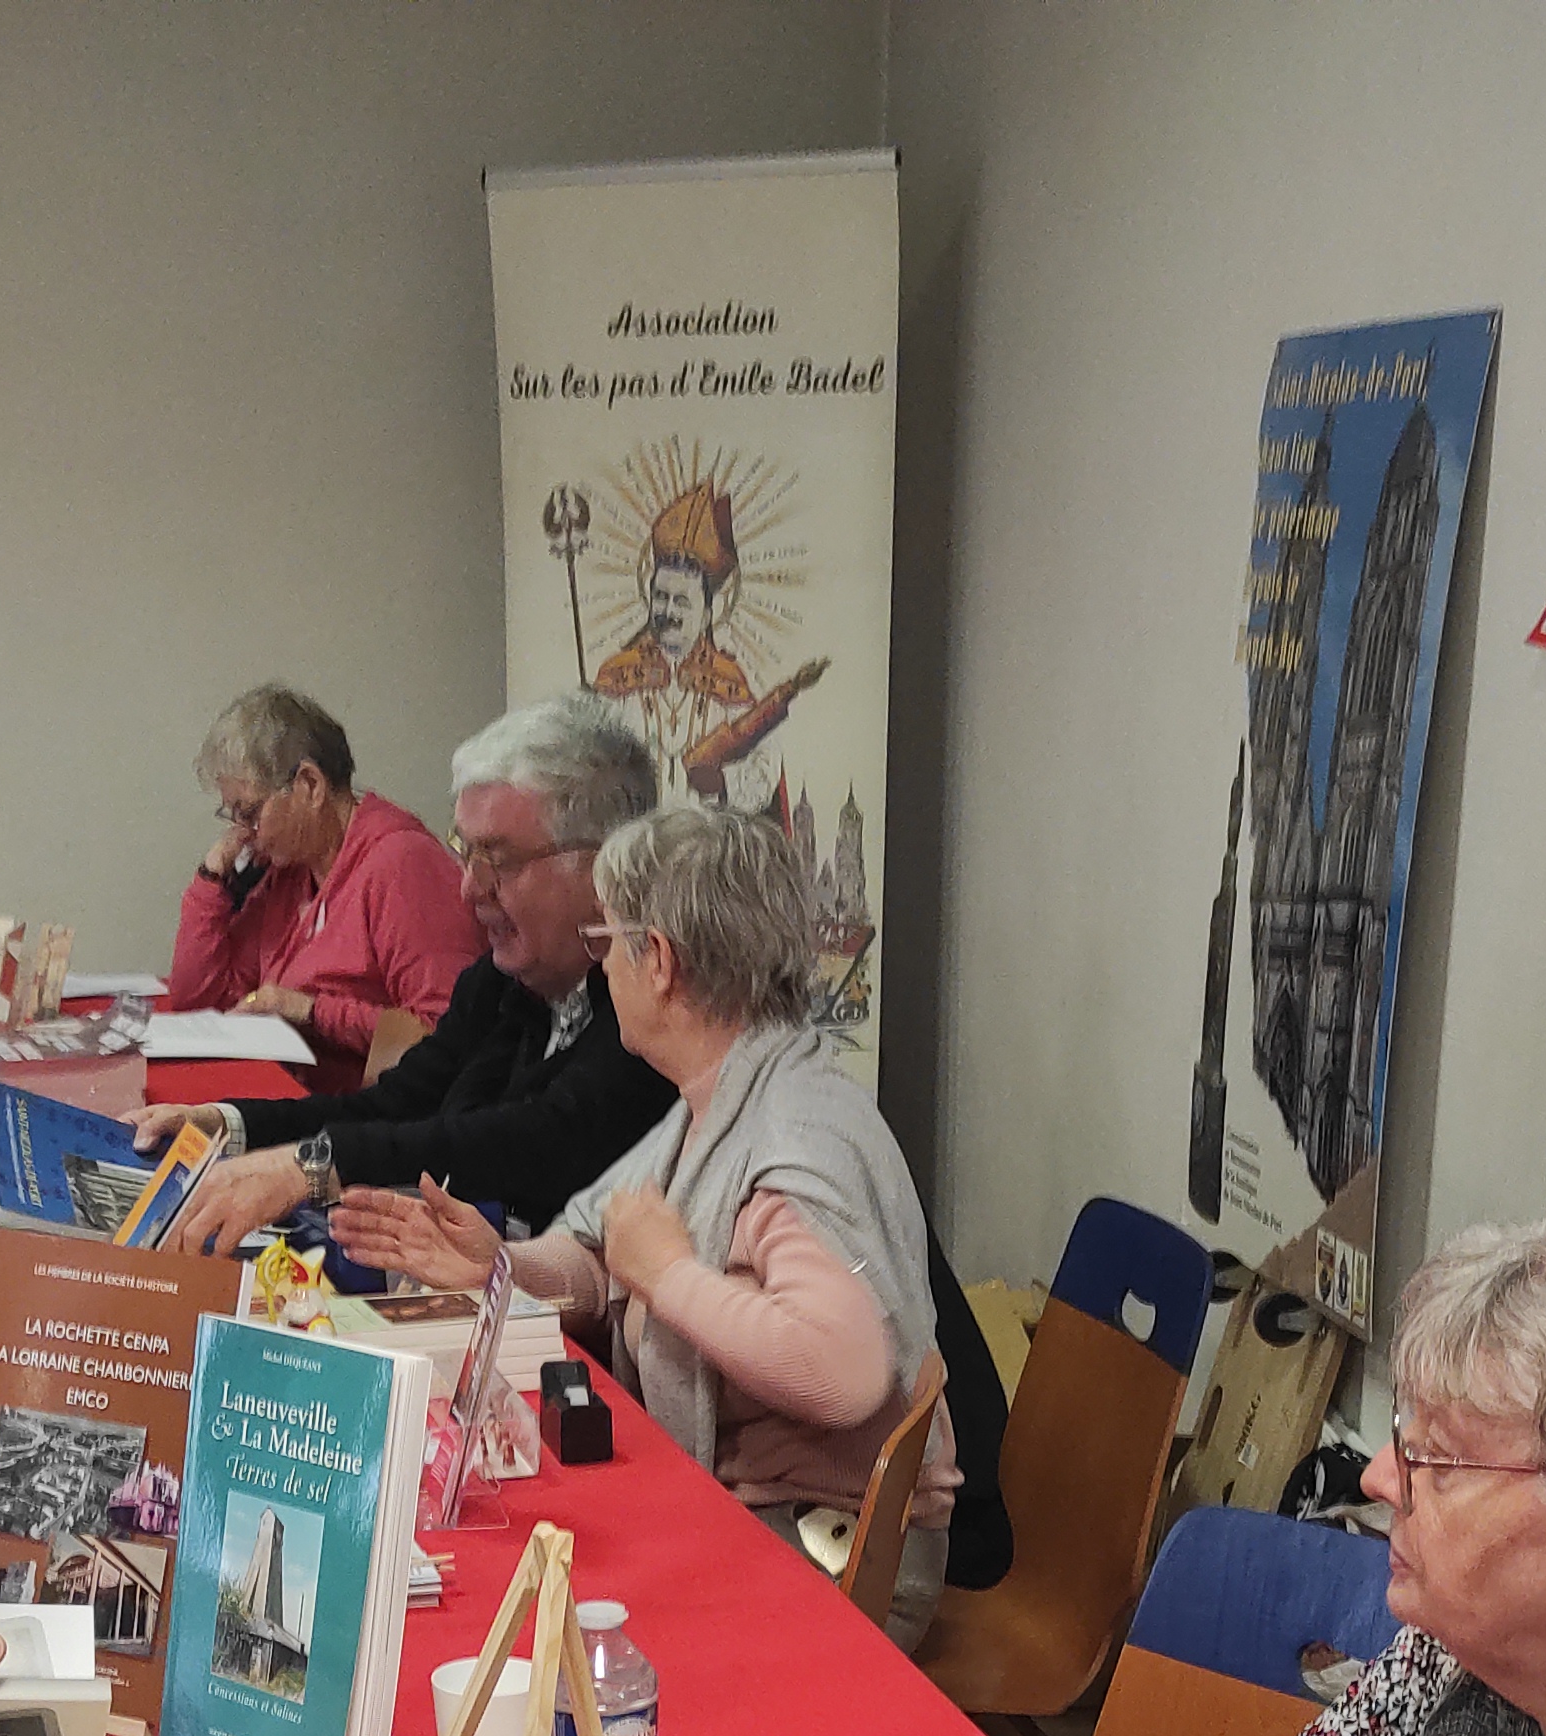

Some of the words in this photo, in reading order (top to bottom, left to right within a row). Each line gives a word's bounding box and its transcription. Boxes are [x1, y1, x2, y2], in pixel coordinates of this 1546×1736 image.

[607, 300, 779, 339] Association
[510, 361, 552, 400] Sur
[560, 362, 601, 400] les
[607, 376, 659, 411] pas
[785, 354, 886, 397] Badel
[10, 1344, 81, 1375] LORRAINE
[25, 1316, 43, 1339] LA
[45, 1319, 122, 1349] ROCHETTE
[122, 1329, 171, 1356] CENPA
[65, 1385, 110, 1411] EMCO
[220, 1379, 339, 1436] Laneuveville
[211, 1412, 235, 1441] &
[239, 1417, 264, 1451] La
[267, 1423, 364, 1477] Madeleine
[225, 1451, 278, 1490] Terres
[282, 1464, 303, 1497] de
[306, 1473, 333, 1506] sel
